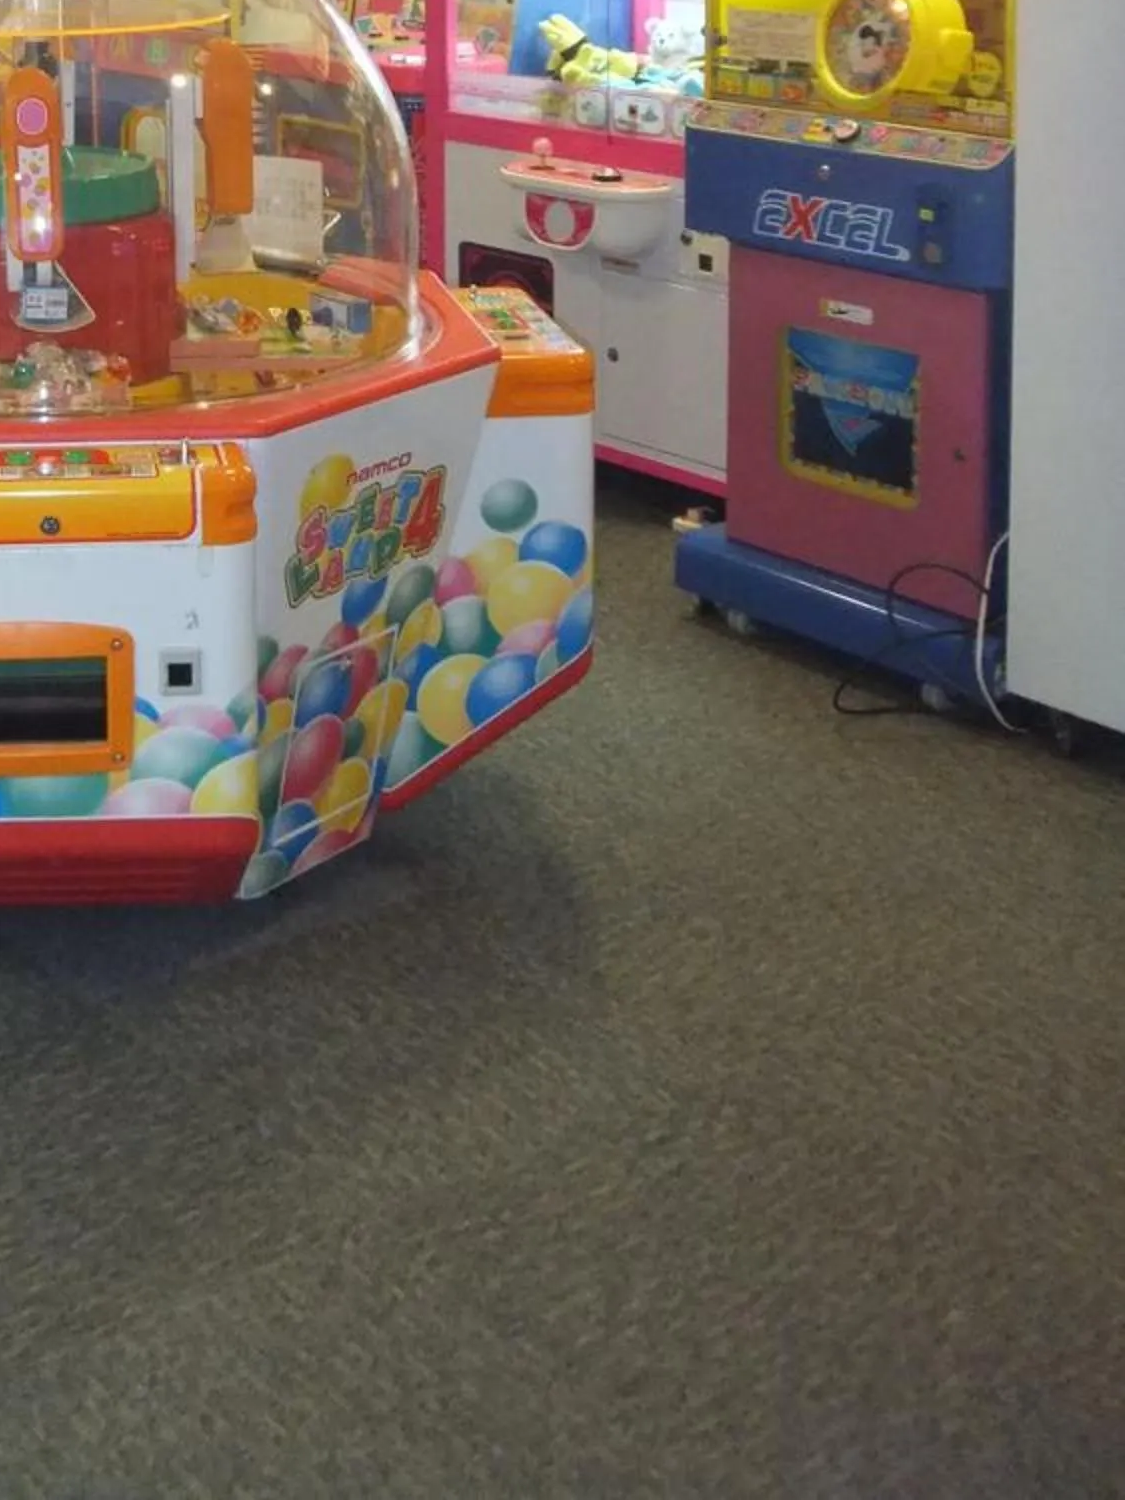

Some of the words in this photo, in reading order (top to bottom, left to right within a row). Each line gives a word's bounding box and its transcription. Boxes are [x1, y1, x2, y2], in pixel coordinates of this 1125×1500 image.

[347, 451, 413, 487] namco
[296, 470, 424, 566] SWEET
[402, 463, 448, 558] 4
[284, 522, 402, 610] LAND
